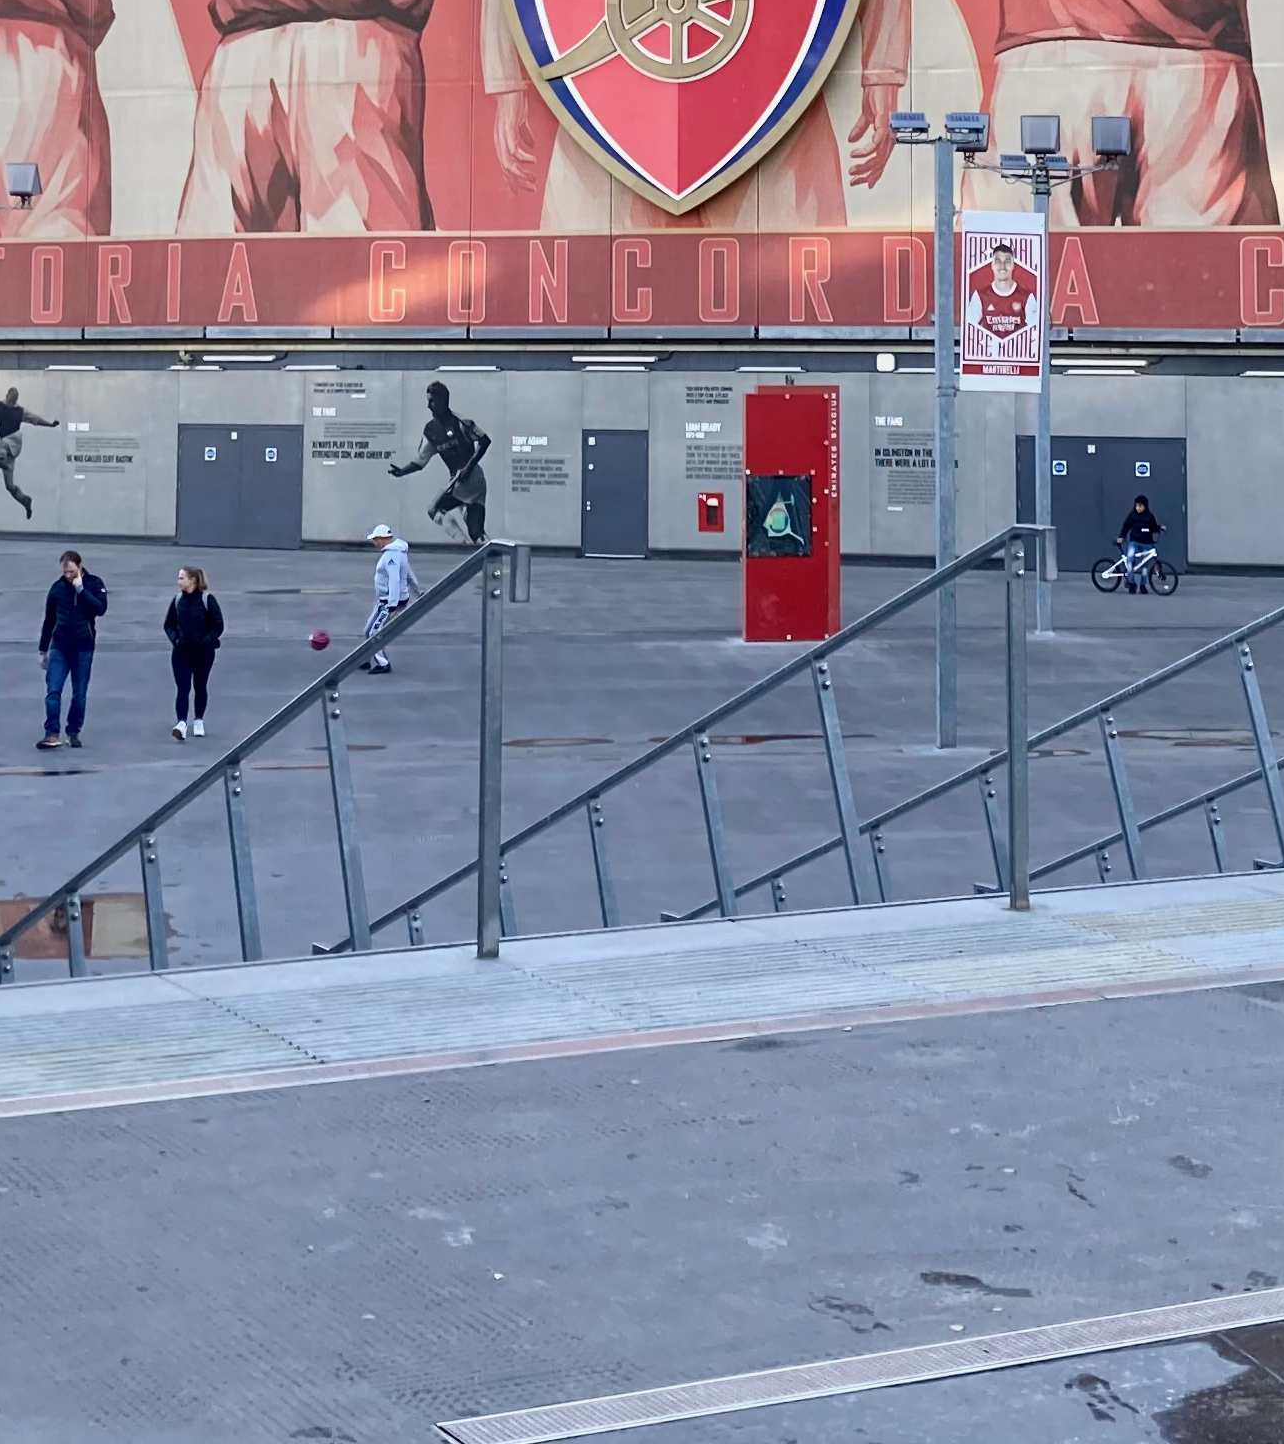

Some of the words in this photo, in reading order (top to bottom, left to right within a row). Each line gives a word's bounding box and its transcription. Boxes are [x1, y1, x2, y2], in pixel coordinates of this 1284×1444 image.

[368, 236, 1101, 326] CONCORDA
[998, 324, 1037, 359] HOME
[875, 448, 881, 457] IN
[914, 448, 921, 457] IN
